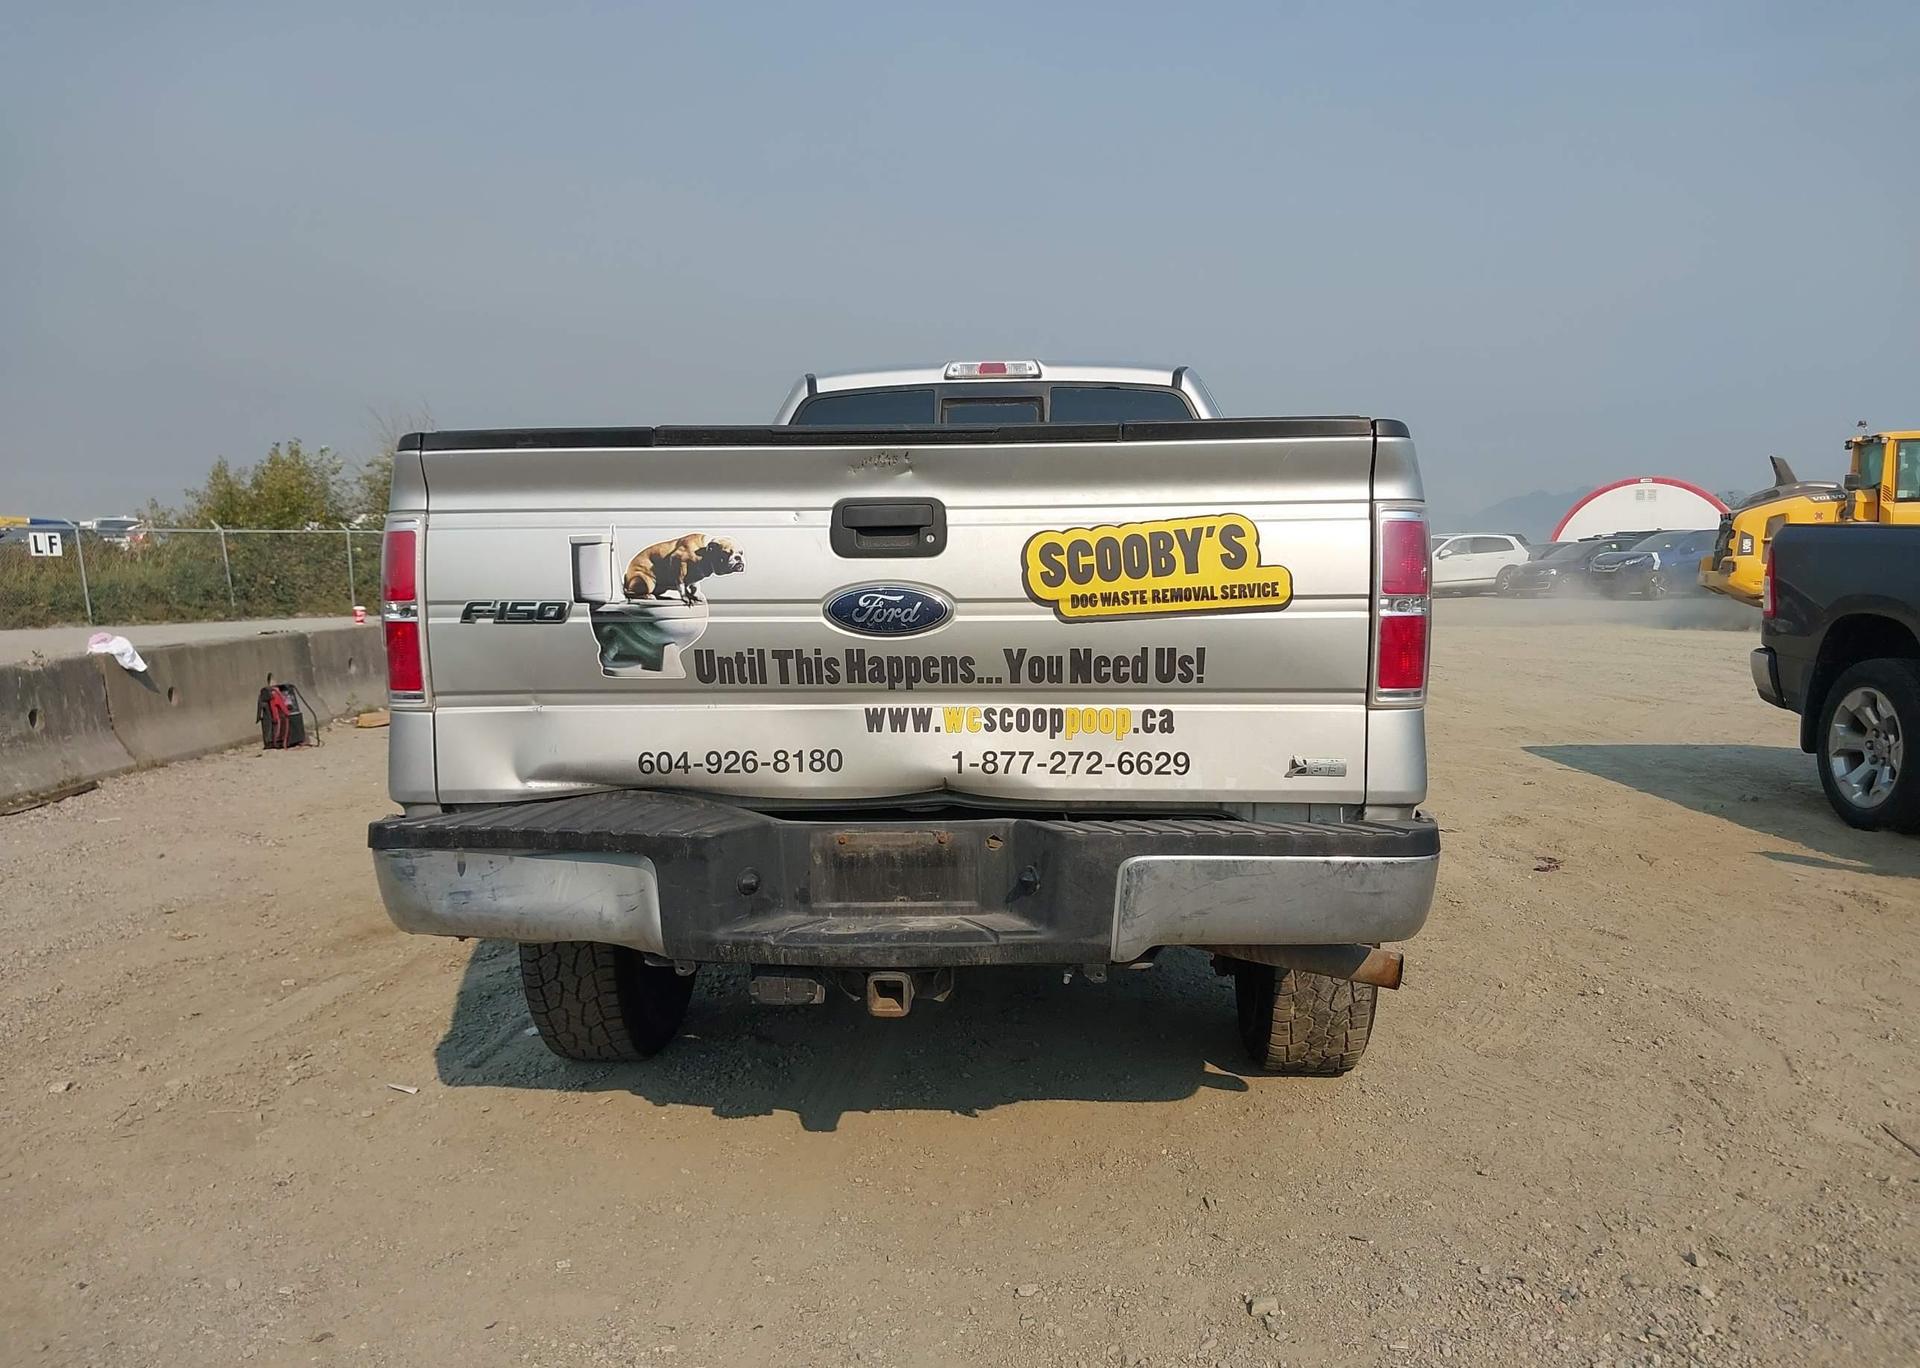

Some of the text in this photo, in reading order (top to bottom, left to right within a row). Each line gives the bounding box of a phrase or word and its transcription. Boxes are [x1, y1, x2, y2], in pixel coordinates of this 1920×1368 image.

[1038, 523, 1248, 588] SCOOBY'S
[852, 593, 922, 624] Ford
[1070, 581, 1280, 609] DOG WASTE REMOVAL SERVICE
[694, 648, 768, 685] Until
[771, 648, 841, 685] This
[1069, 646, 1149, 684] Need
[1155, 647, 1207, 684] Us!
[864, 706, 1175, 741] www.wescooppoop.ca
[638, 748, 844, 775] 604-926-8180
[951, 750, 1191, 776] 1-877-272-6629
